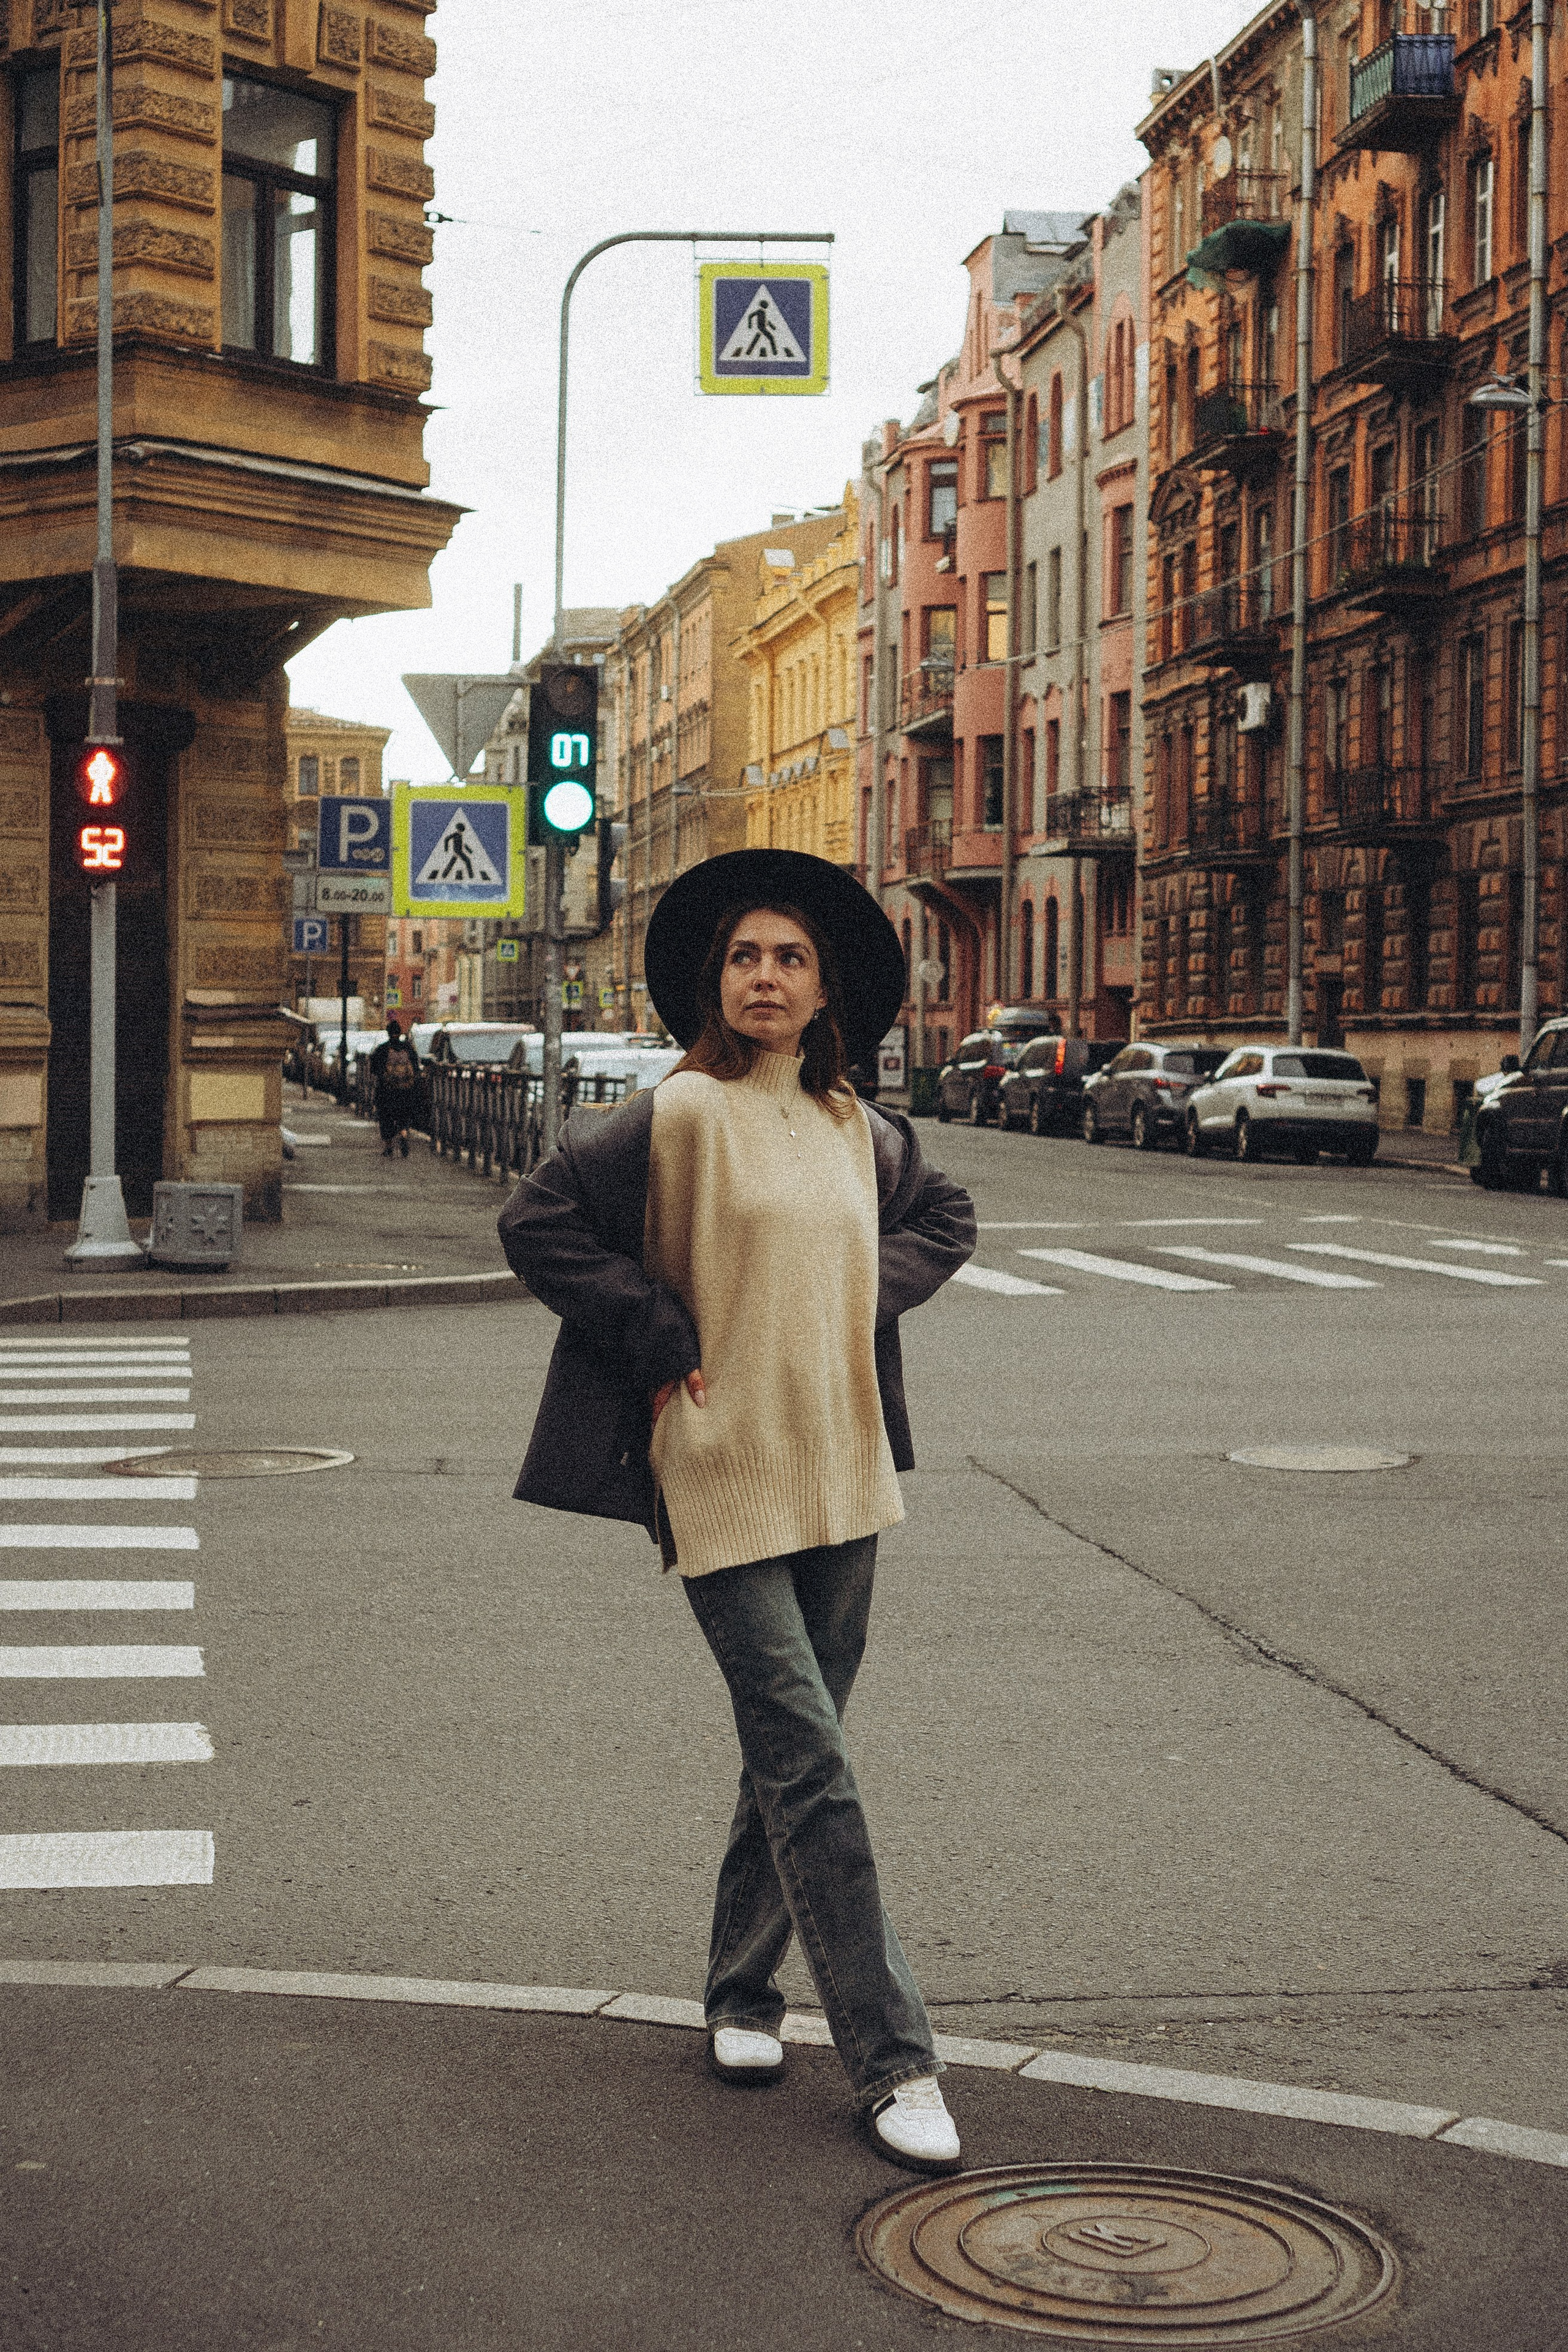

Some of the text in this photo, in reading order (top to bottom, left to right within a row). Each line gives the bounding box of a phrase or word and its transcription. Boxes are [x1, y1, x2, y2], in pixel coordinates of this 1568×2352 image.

[551, 733, 589, 767] 07
[81, 827, 124, 867] 52
[339, 805, 379, 862] P
[303, 922, 321, 948] P
